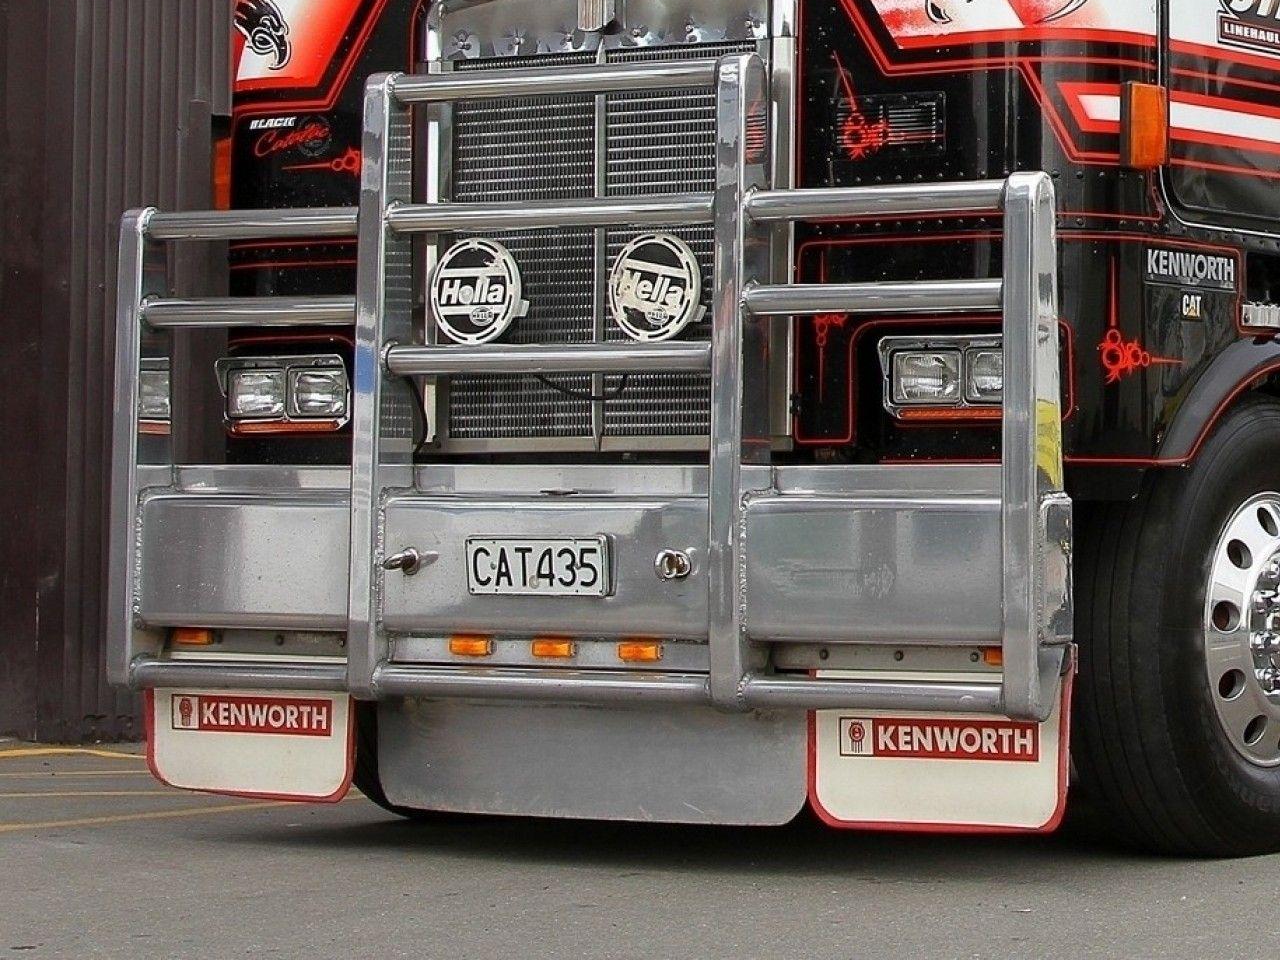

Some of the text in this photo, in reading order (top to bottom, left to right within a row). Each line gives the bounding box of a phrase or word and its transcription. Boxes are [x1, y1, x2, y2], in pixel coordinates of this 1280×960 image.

[1222, 21, 1280, 45] LINEHAUL
[249, 116, 298, 131] BLACK
[1147, 248, 1234, 281] KENWORTH
[1182, 293, 1202, 318] CAT
[471, 546, 599, 588] CAT435
[202, 701, 328, 731] KENWORTH
[878, 724, 1033, 755] KENWORTH
